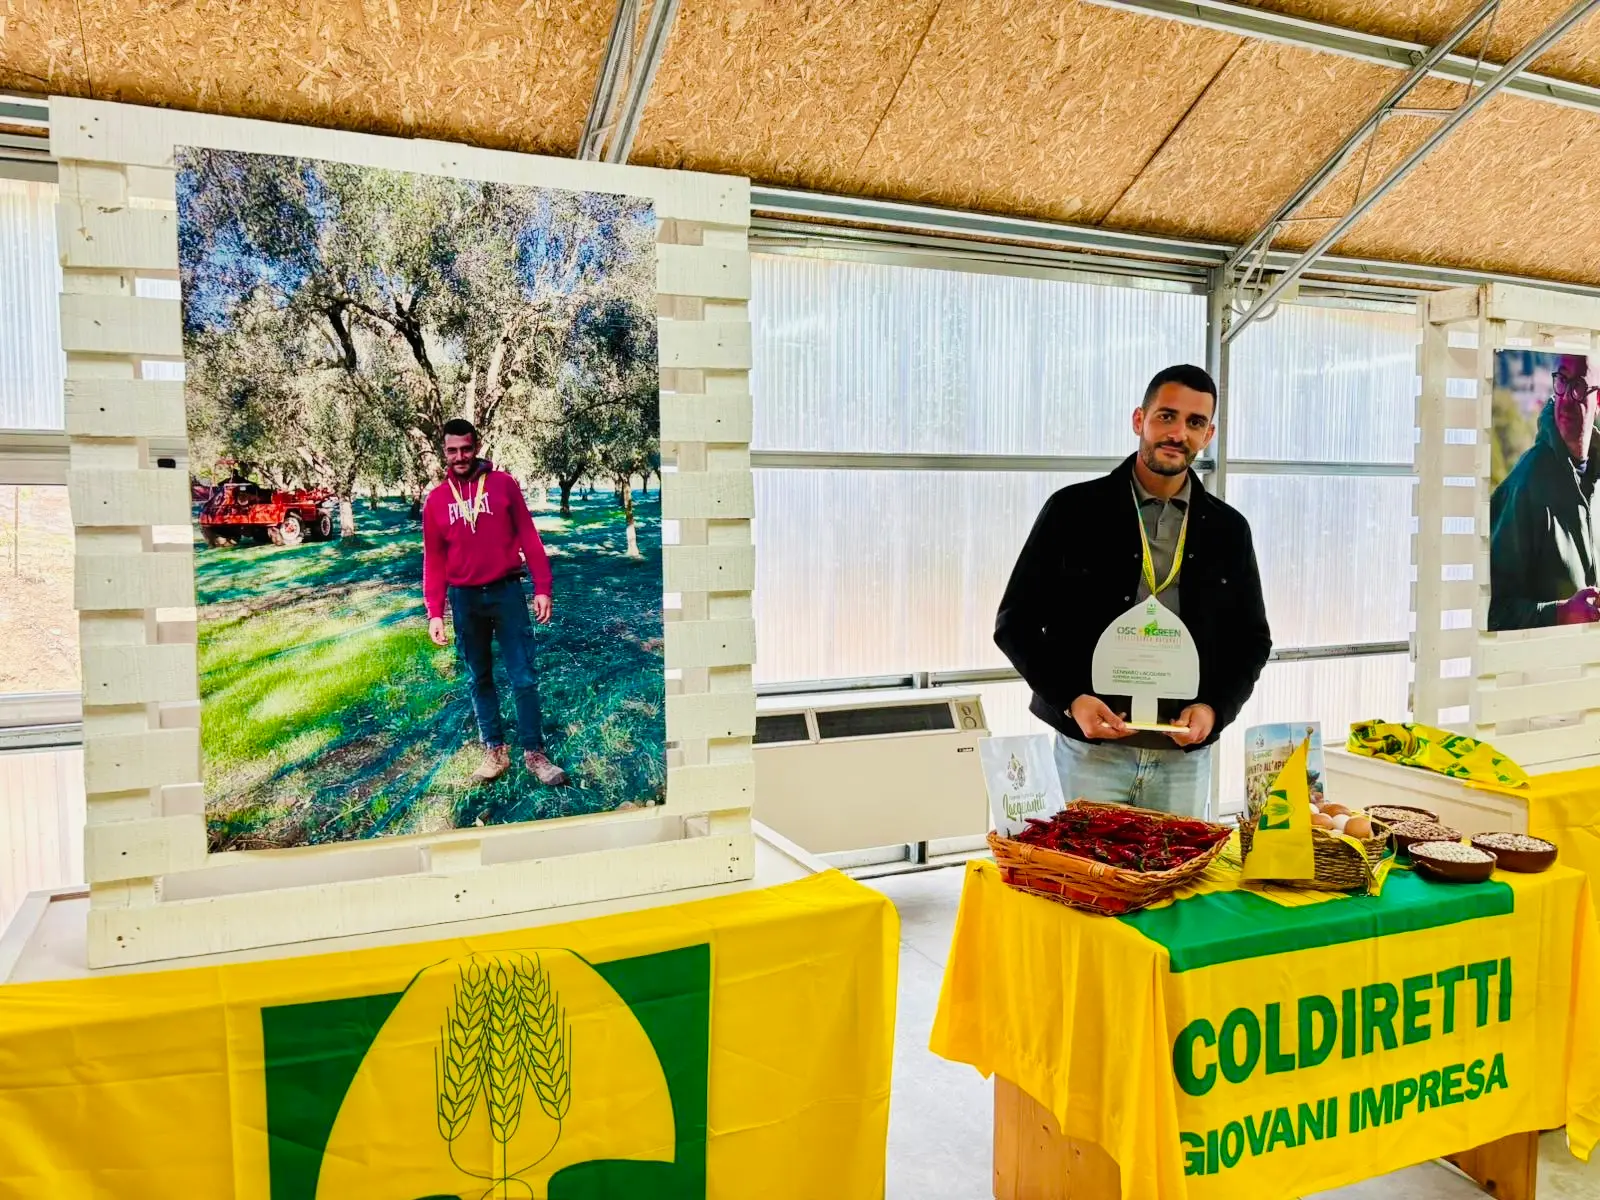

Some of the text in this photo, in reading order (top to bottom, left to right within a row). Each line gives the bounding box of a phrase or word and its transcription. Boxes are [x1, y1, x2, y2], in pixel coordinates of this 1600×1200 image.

[1173, 957, 1511, 1096] COLDIRETTI
[1180, 1052, 1508, 1176] GIOVANI IMPRESA
